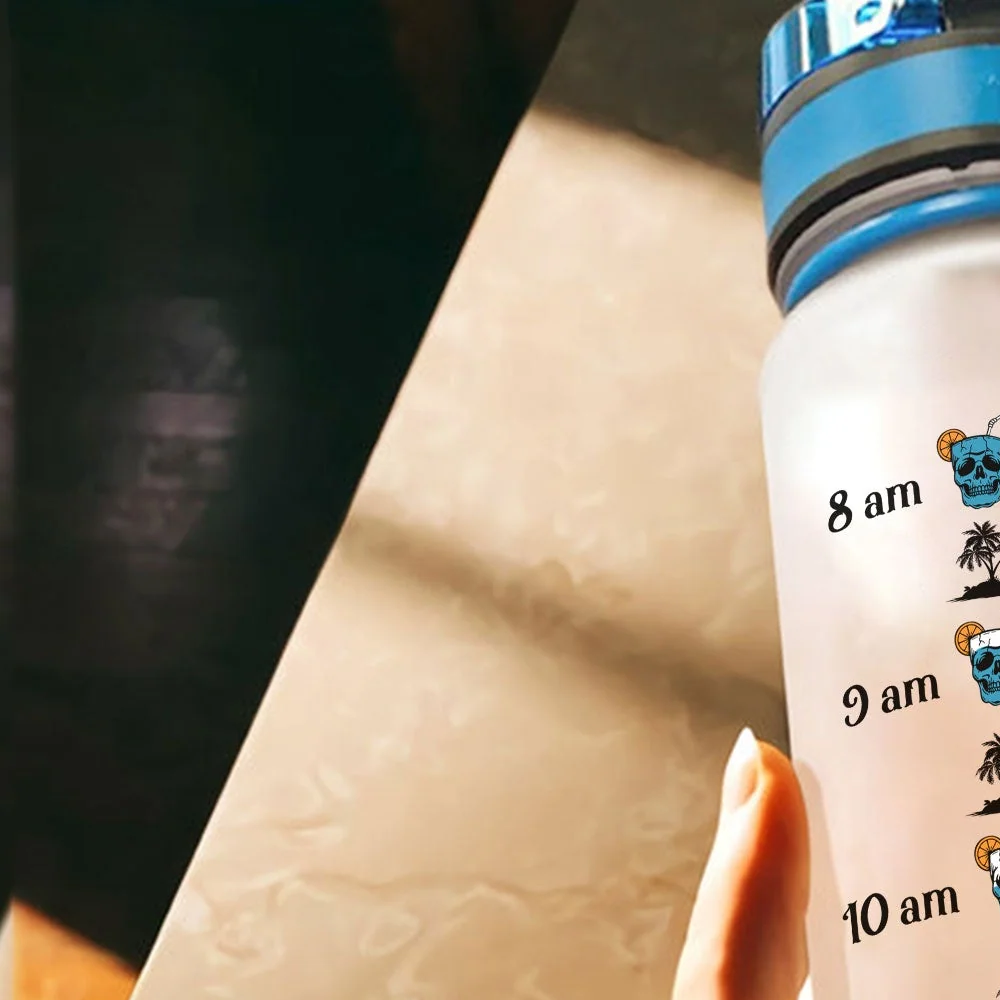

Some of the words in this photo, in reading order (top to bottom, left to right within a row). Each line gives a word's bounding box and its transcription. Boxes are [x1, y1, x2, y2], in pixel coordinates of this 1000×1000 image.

[827, 489, 853, 533] 8
[864, 480, 923, 519] am
[842, 684, 869, 728] 9
[881, 674, 941, 714] am
[842, 892, 889, 945] 10
[900, 886, 960, 926] am
